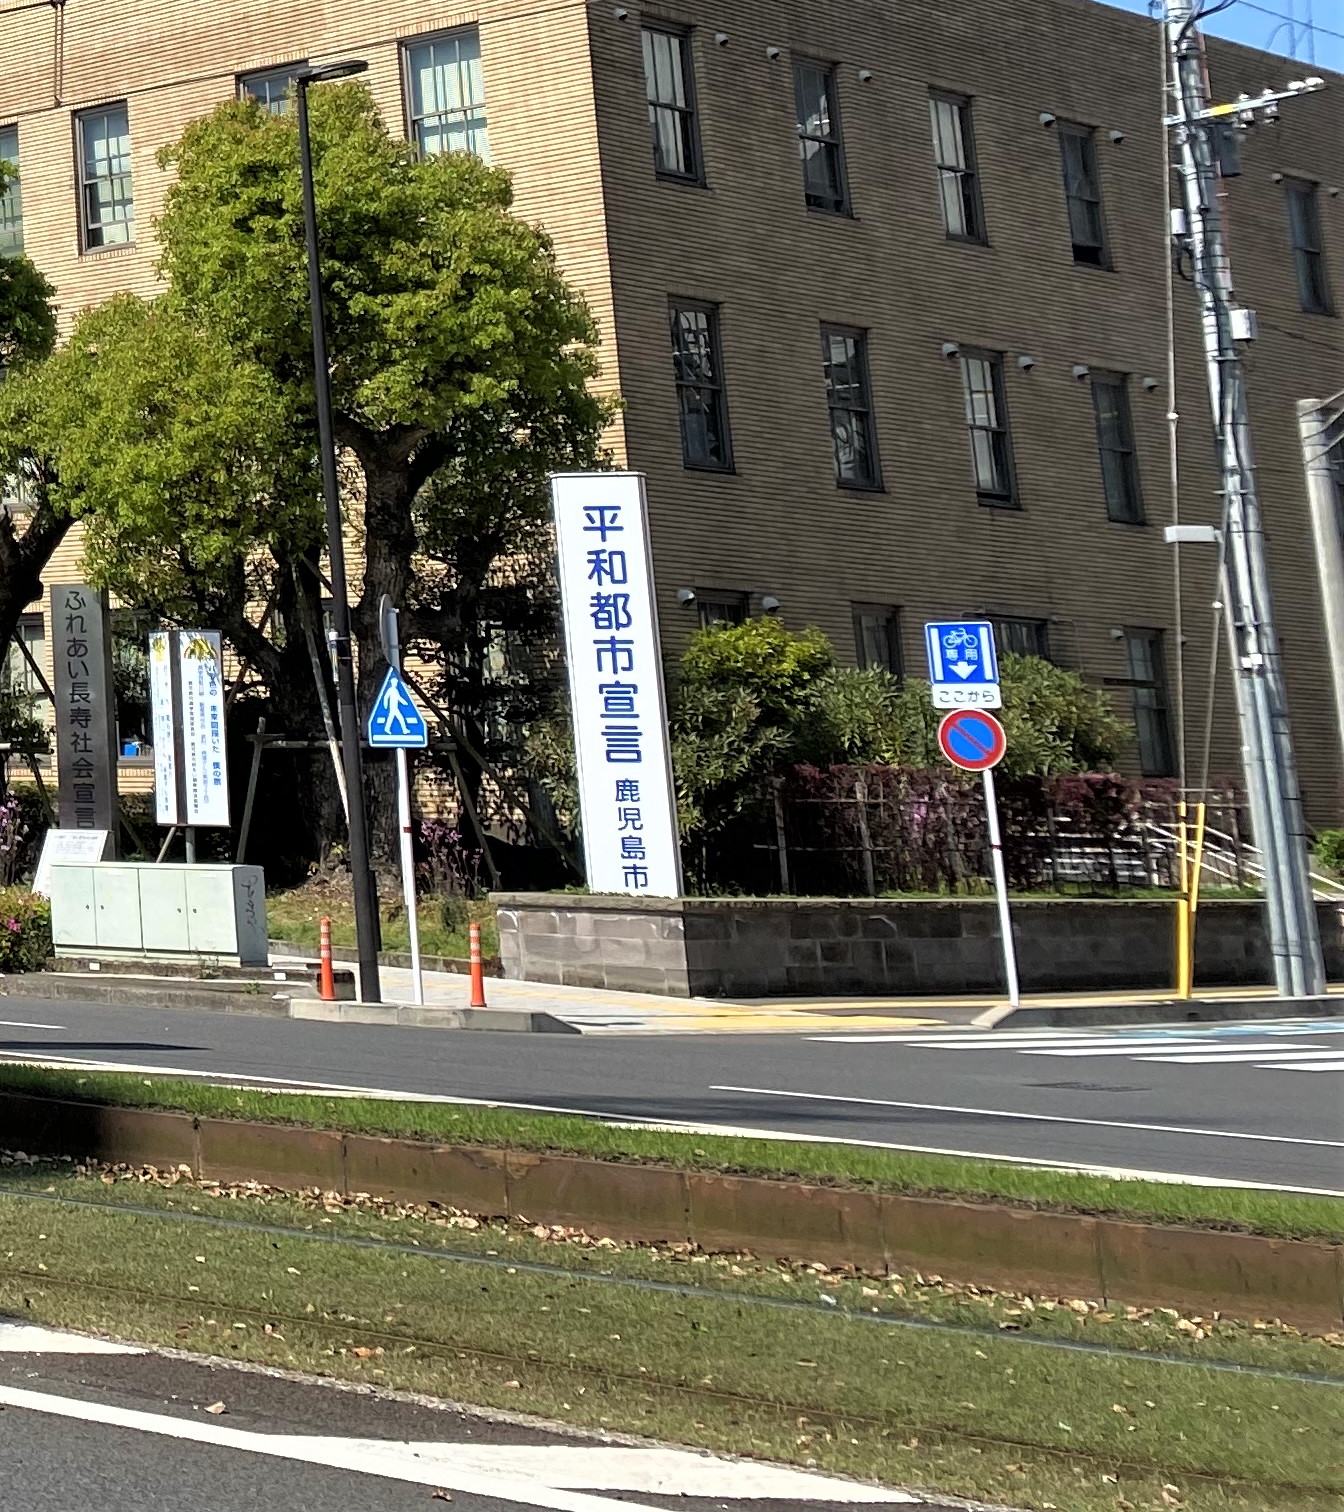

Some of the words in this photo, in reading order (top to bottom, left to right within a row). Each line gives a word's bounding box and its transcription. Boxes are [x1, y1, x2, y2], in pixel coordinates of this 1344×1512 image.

[64, 590, 96, 830] ふれあい長寿社会宣言
[582, 504, 643, 765] 平和都市宣言
[615, 778, 650, 890] 鹿児島市
[939, 689, 996, 703] ここから
[945, 648, 979, 661] 専用
